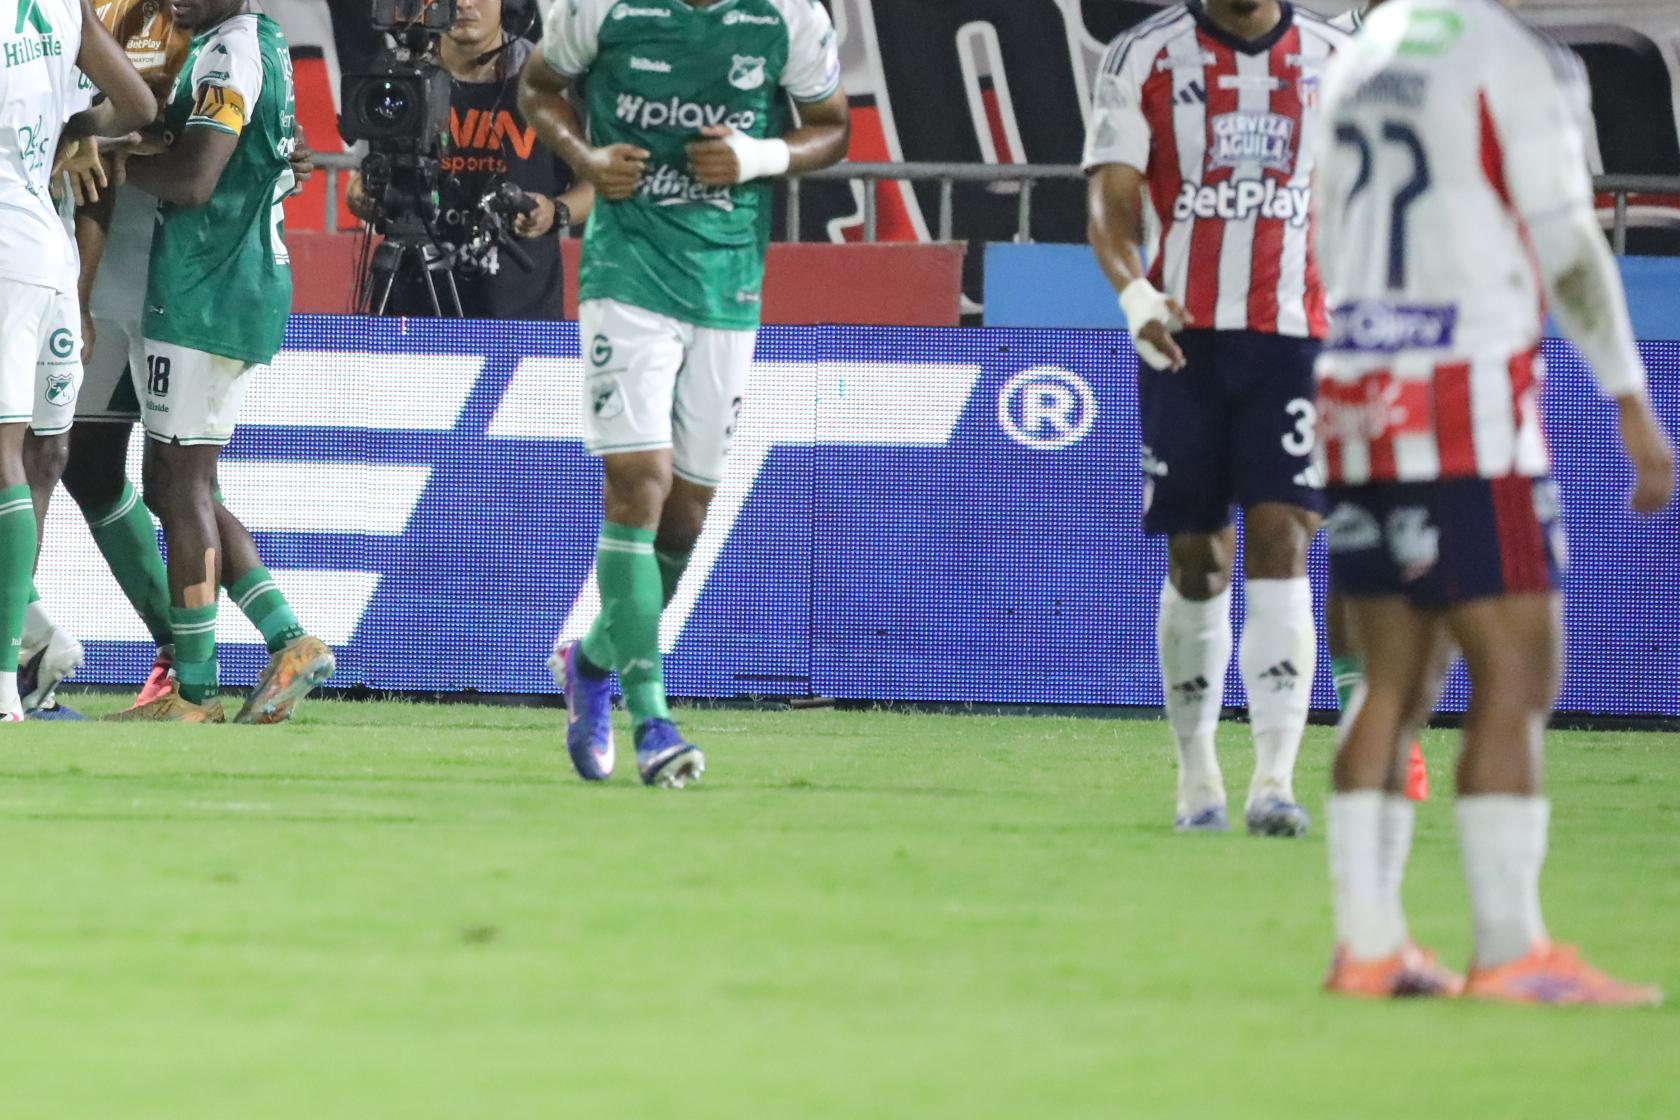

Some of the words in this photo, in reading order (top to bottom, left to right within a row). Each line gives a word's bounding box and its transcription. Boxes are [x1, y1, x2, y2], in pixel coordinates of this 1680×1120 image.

[1216, 111, 1291, 137] CERVEZA
[440, 154, 508, 174] sports
[1172, 176, 1313, 229] BetPlay
[146, 354, 171, 398] 18
